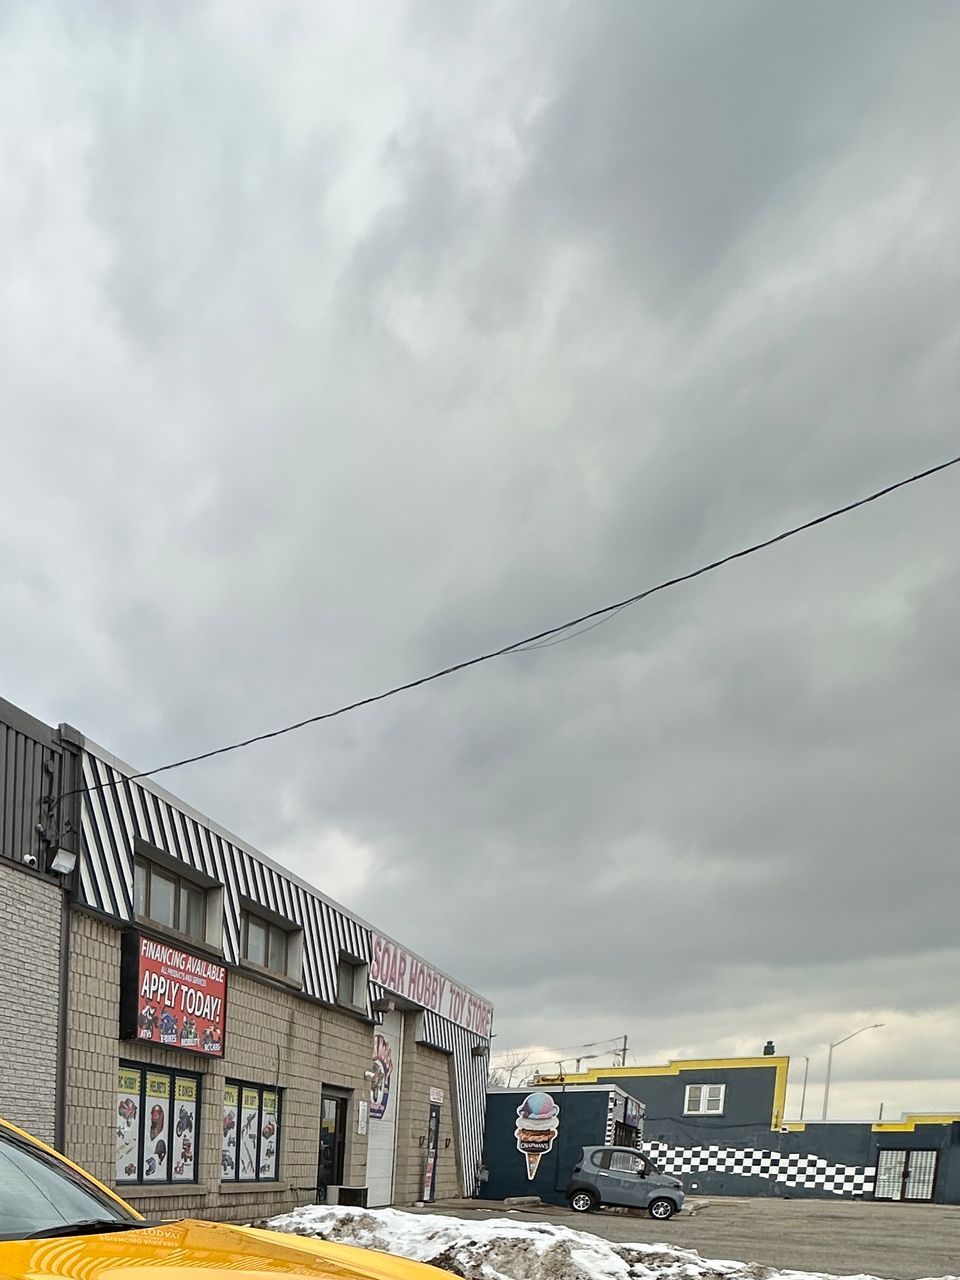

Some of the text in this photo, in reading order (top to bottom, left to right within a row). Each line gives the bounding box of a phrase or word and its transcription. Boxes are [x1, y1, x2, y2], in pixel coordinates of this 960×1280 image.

[141, 939, 225, 982] FINANCING AVAILABLE
[371, 935, 491, 1037] SOAR HOBBY TOY STORE
[141, 970, 222, 1023] APPLY TODAY!
